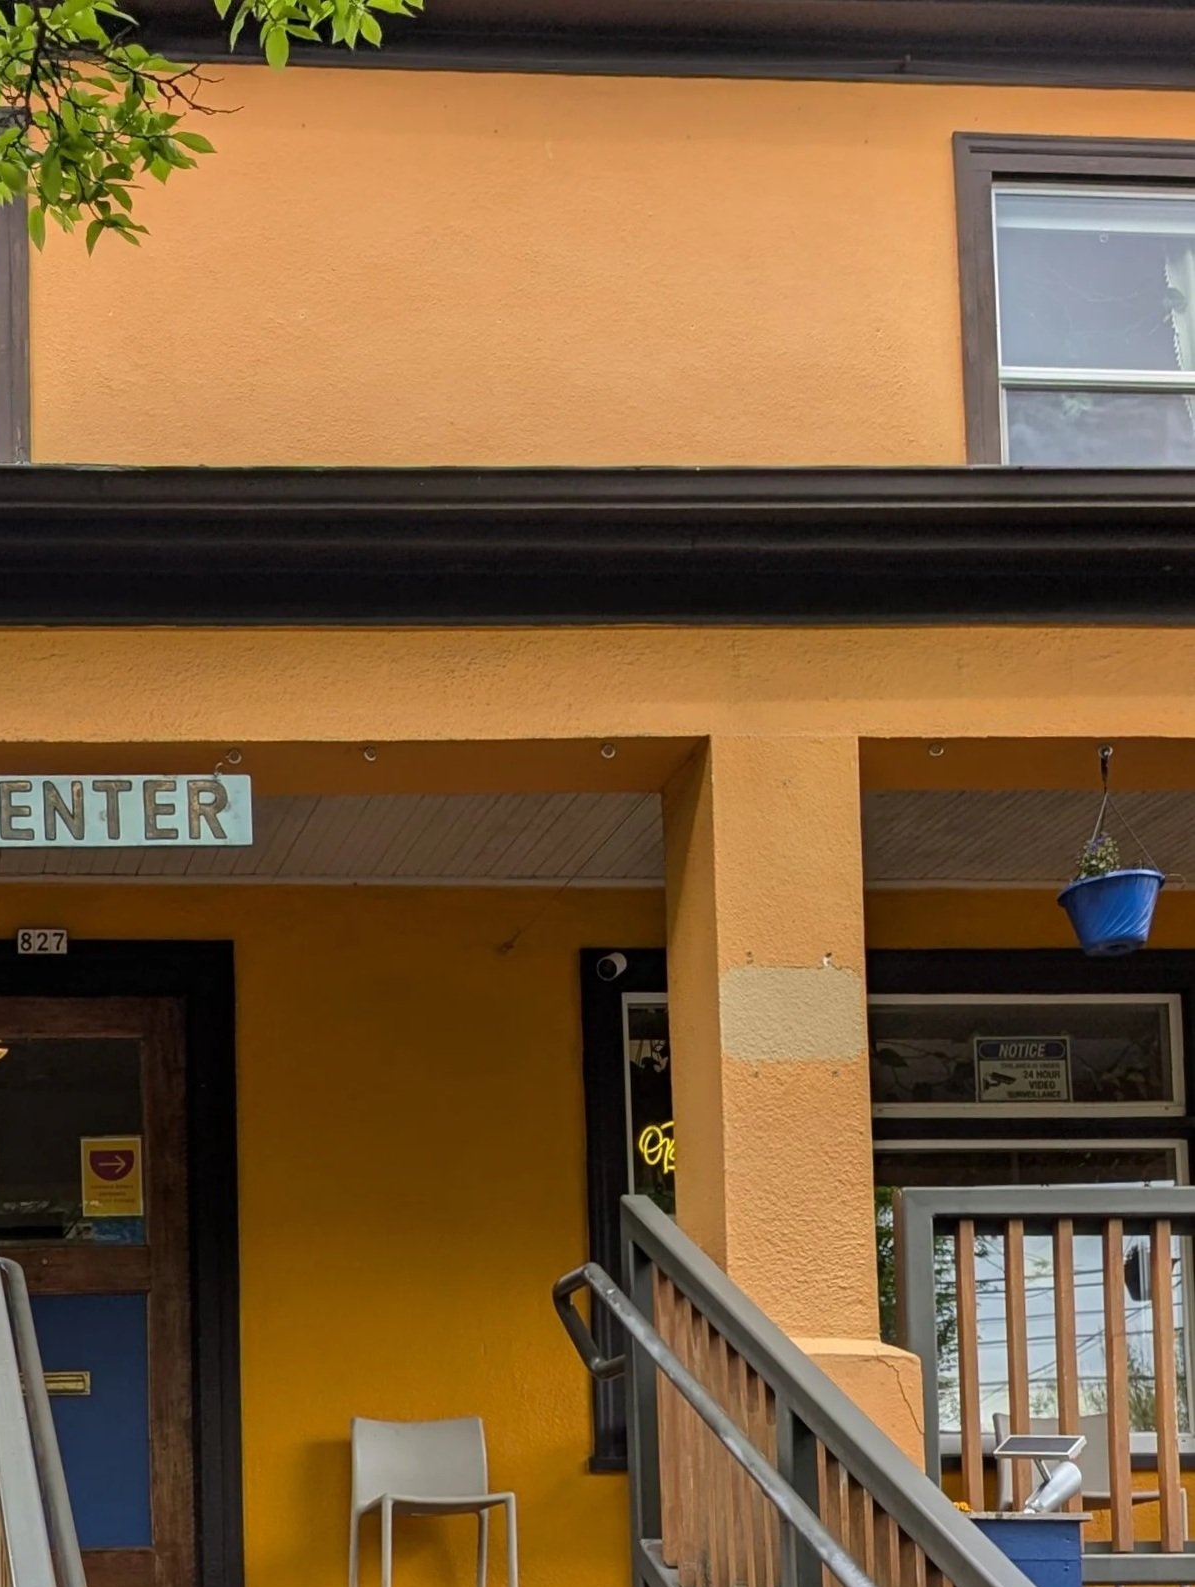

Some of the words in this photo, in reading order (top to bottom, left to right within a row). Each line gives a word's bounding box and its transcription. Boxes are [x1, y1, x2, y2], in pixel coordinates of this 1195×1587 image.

[20, 932, 65, 951] 827
[998, 1043, 1046, 1058] NOTICE
[1023, 1070, 1034, 1079] 24
[1036, 1070, 1061, 1079] HOUR
[1029, 1080, 1056, 1089] VIDEO
